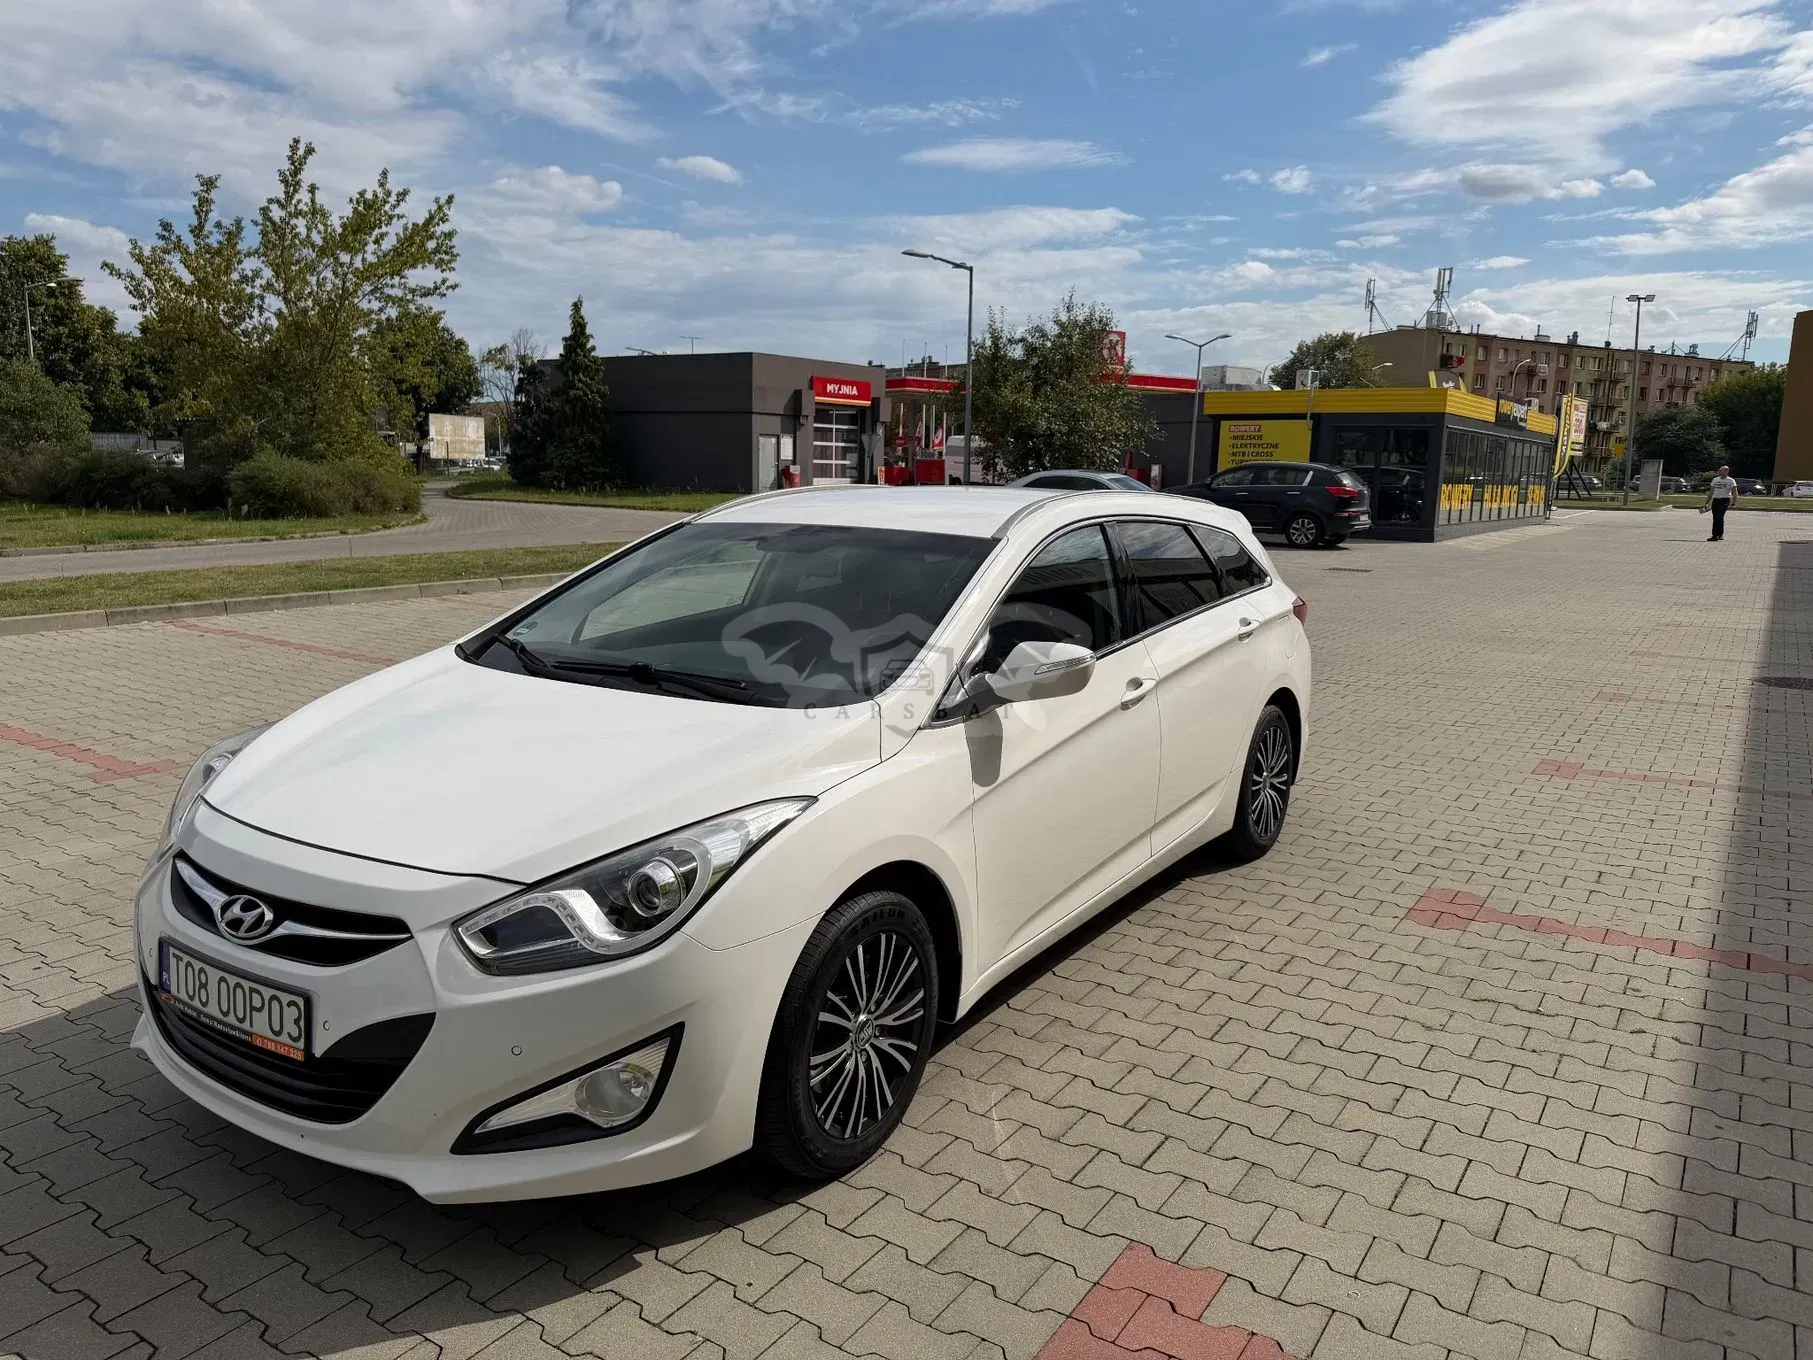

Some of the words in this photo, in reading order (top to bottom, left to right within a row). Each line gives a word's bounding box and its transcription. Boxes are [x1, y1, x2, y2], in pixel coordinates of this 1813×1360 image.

[826, 383, 858, 396] MYJNIA
[1440, 483, 1474, 511] ROWERY
[162, 971, 170, 985] PL
